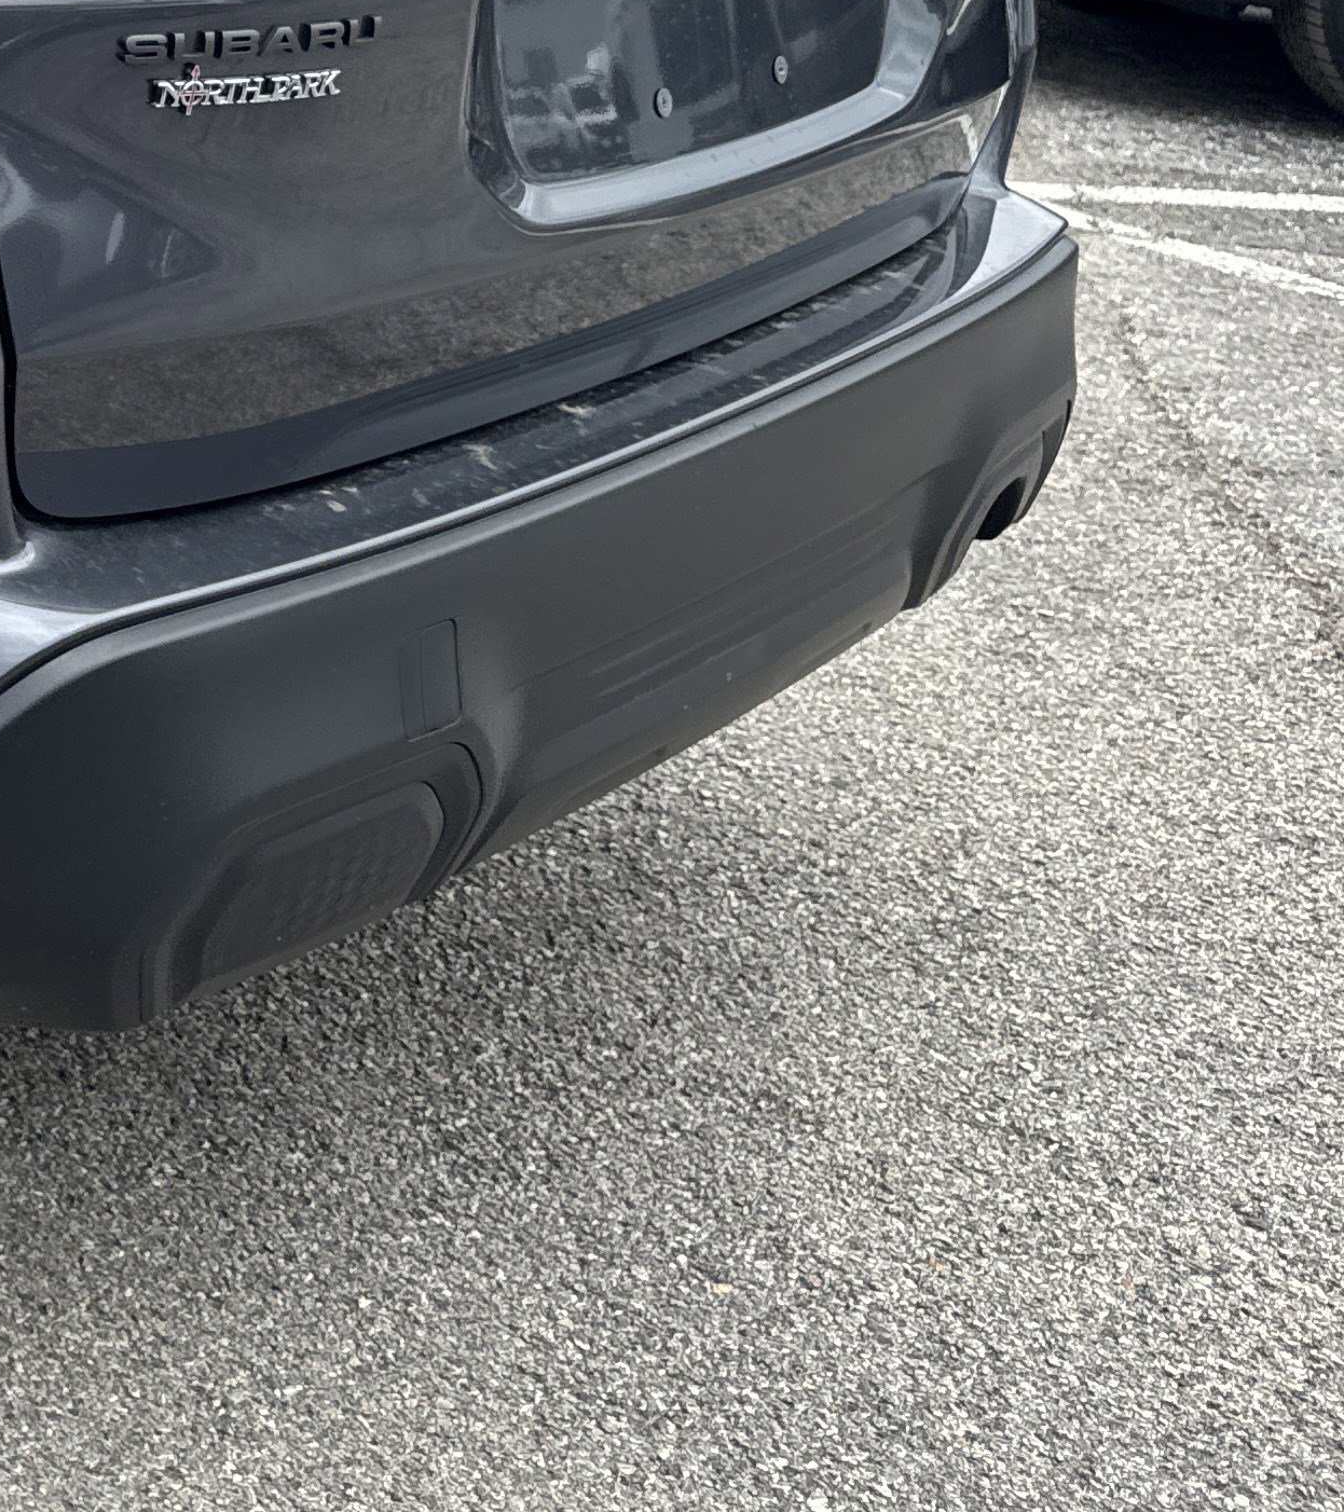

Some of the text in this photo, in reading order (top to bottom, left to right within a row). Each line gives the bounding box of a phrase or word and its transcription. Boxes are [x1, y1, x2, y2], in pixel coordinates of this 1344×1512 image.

[116, 14, 383, 65] SUBARU
[150, 69, 342, 109] NORTH PARK
